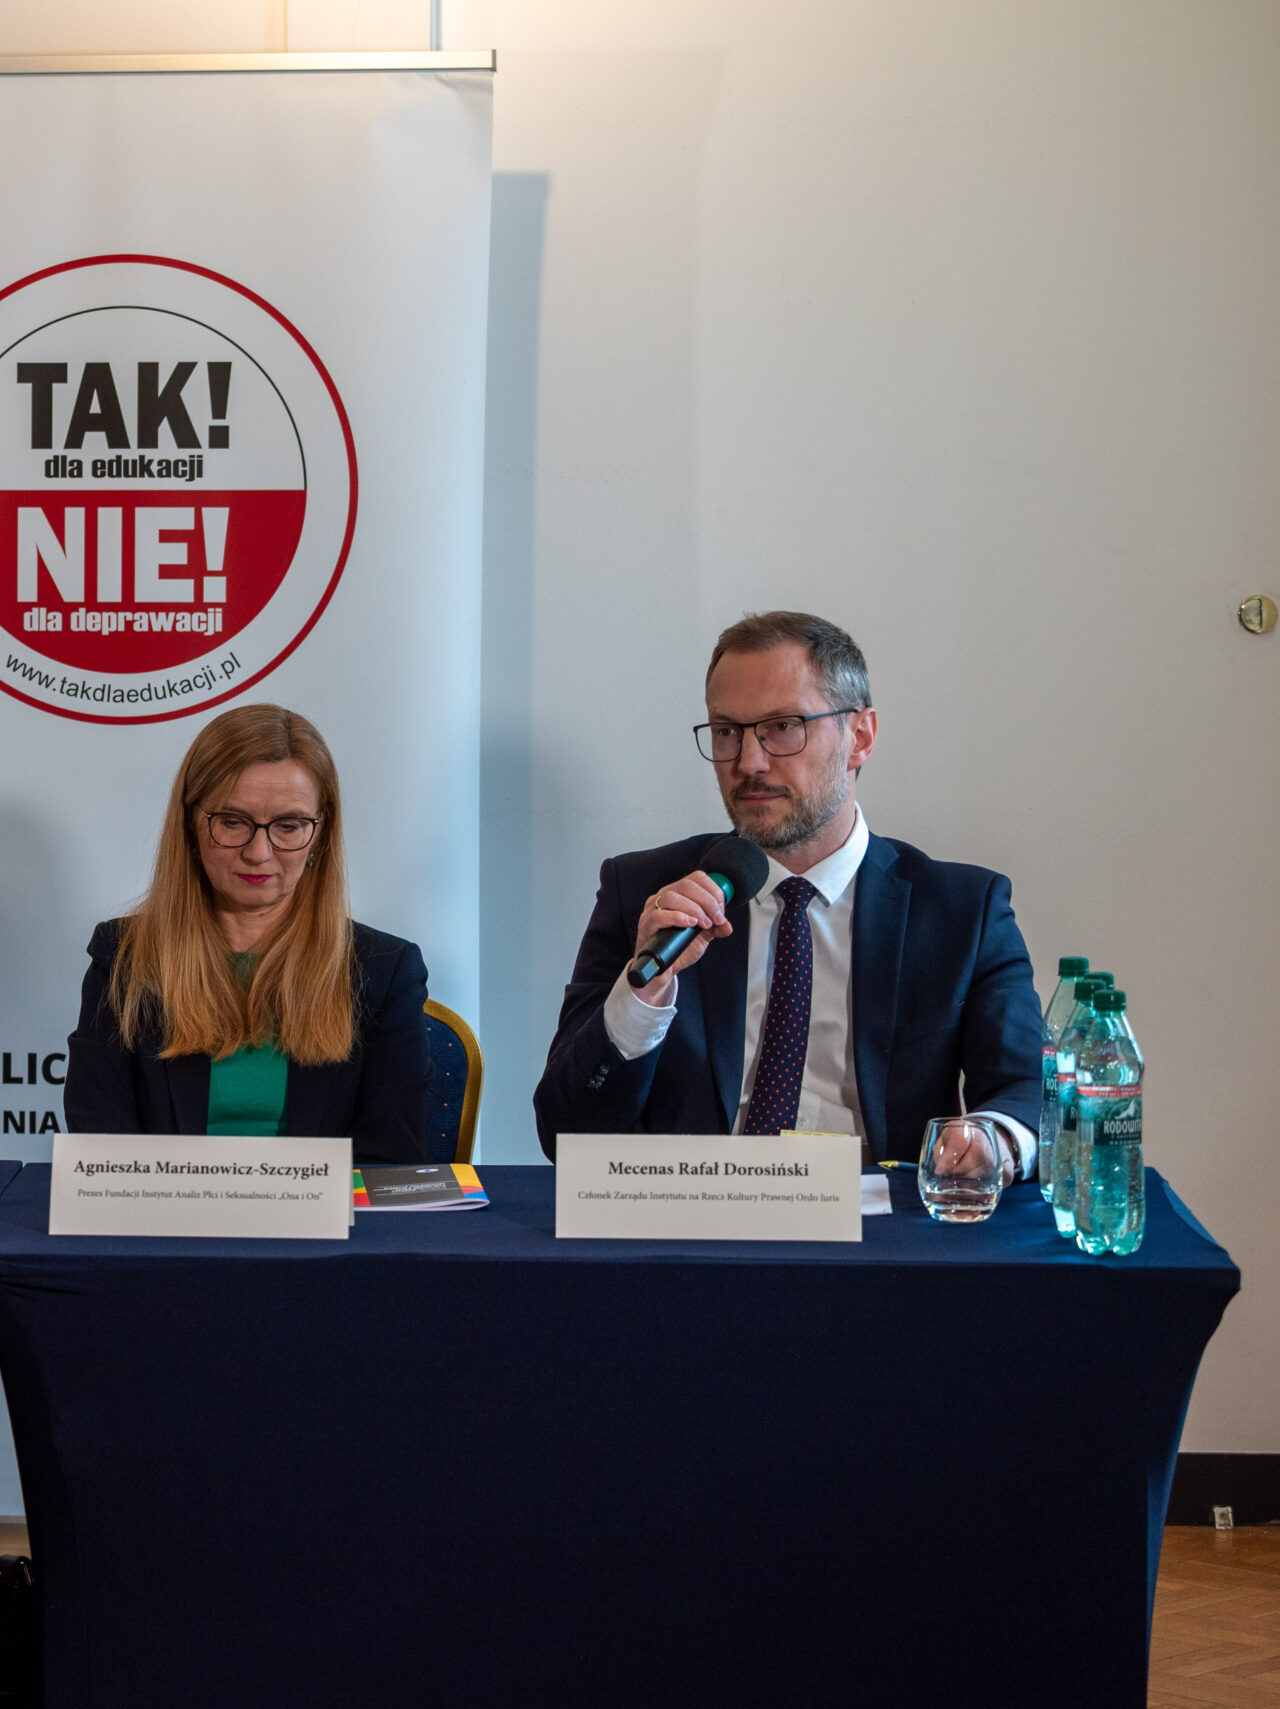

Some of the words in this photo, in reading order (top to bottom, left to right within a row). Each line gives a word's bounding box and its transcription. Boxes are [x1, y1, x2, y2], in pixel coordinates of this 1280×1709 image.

[16, 361, 233, 449] TAK!
[44, 455, 83, 479] dla
[92, 454, 204, 482] edukacji
[16, 506, 230, 603] NIE!
[23, 608, 63, 632] dla
[70, 608, 223, 636] deprawacji
[5, 651, 242, 704] www.takdlaedukacji.pl
[74, 1160, 151, 1177] Agnieszka
[155, 1161, 329, 1180] Marianowicz-Szczygieł
[608, 1161, 674, 1175] Mecenas
[679, 1161, 719, 1175] Rafał
[724, 1162, 809, 1176] Dorosiński
[77, 1189, 103, 1197] Prezes
[105, 1189, 140, 1199] Fundacji
[142, 1189, 173, 1199] Instytut
[577, 1190, 612, 1200] Członek
[650, 1191, 687, 1202] Instytutu
[727, 1192, 759, 1203] Kultury
[760, 1192, 795, 1203] Prawnej
[796, 1193, 818, 1201] Ordo
